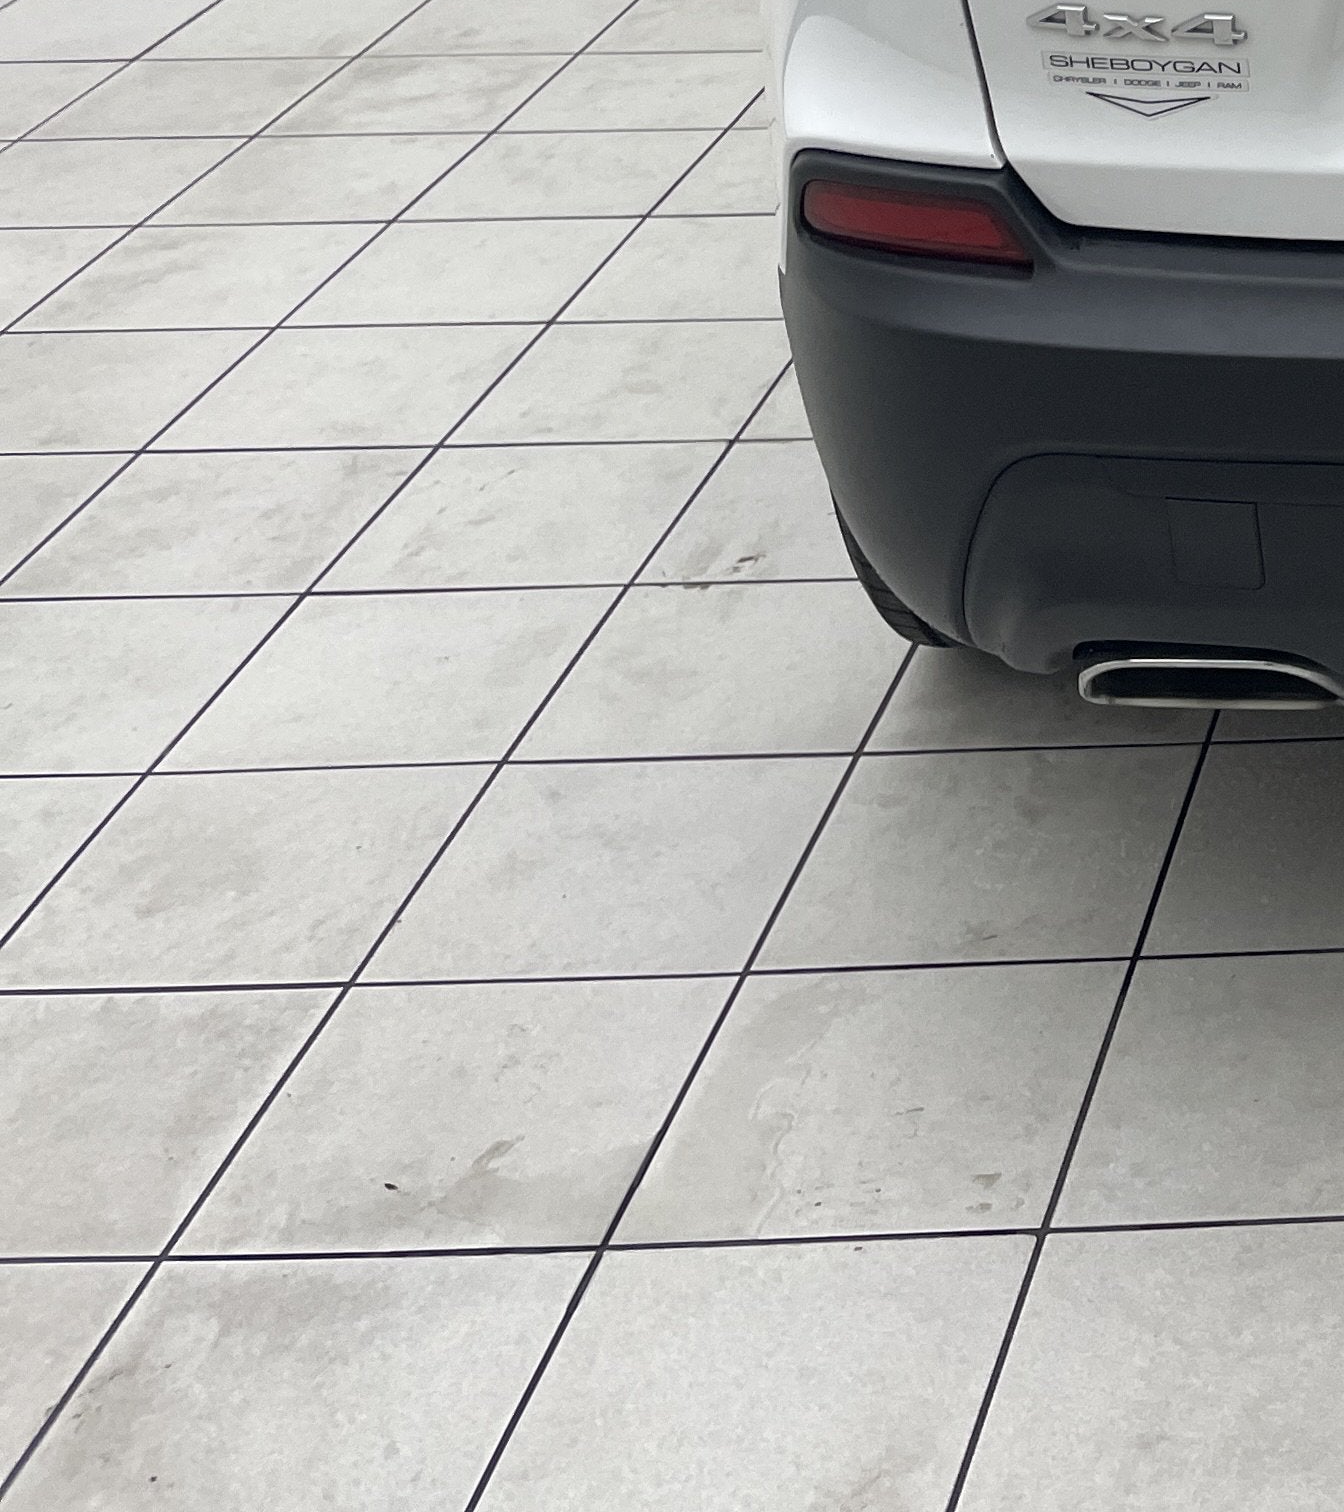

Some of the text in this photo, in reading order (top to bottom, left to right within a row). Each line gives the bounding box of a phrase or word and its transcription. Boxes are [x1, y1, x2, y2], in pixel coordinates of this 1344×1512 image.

[1049, 54, 1241, 74] SHEBOYGAN
[1053, 74, 1242, 90] CHRYSLER DODGE JEEP RAM
